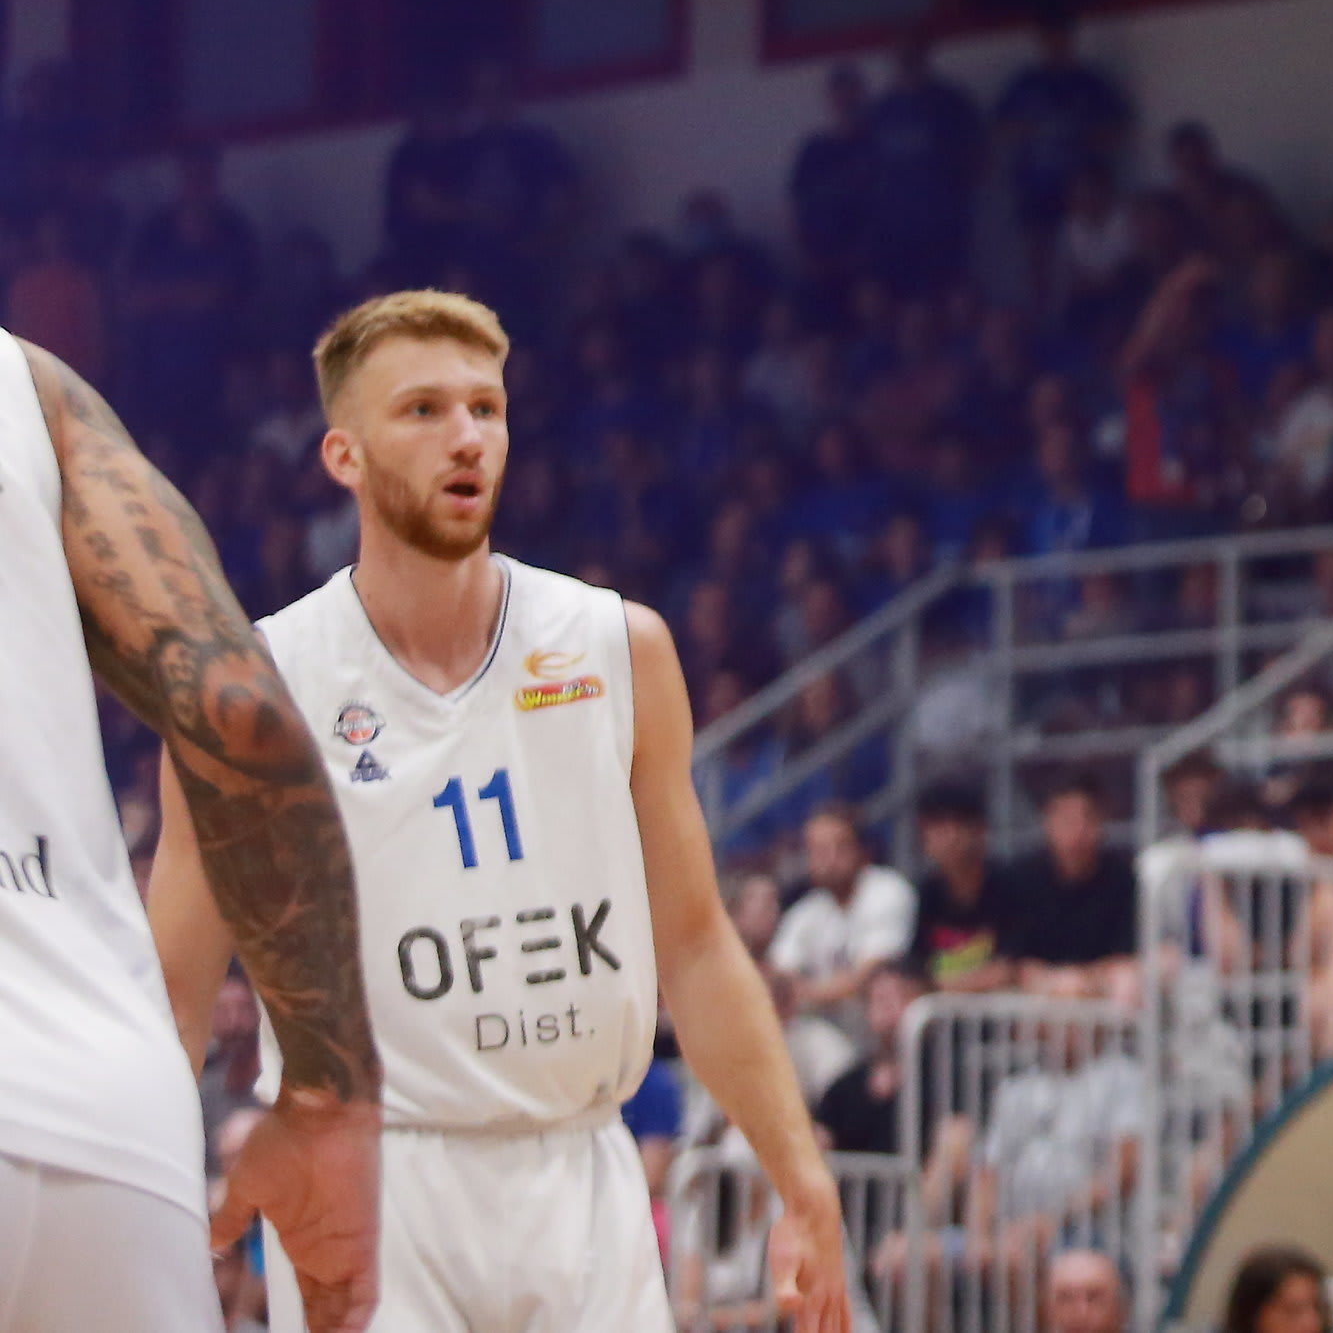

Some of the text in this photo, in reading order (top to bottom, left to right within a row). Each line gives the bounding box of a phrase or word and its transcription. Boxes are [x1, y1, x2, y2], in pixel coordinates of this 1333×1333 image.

[432, 767, 525, 869] 11
[397, 897, 623, 1000] OFEK
[475, 1002, 597, 1052] Dist.
